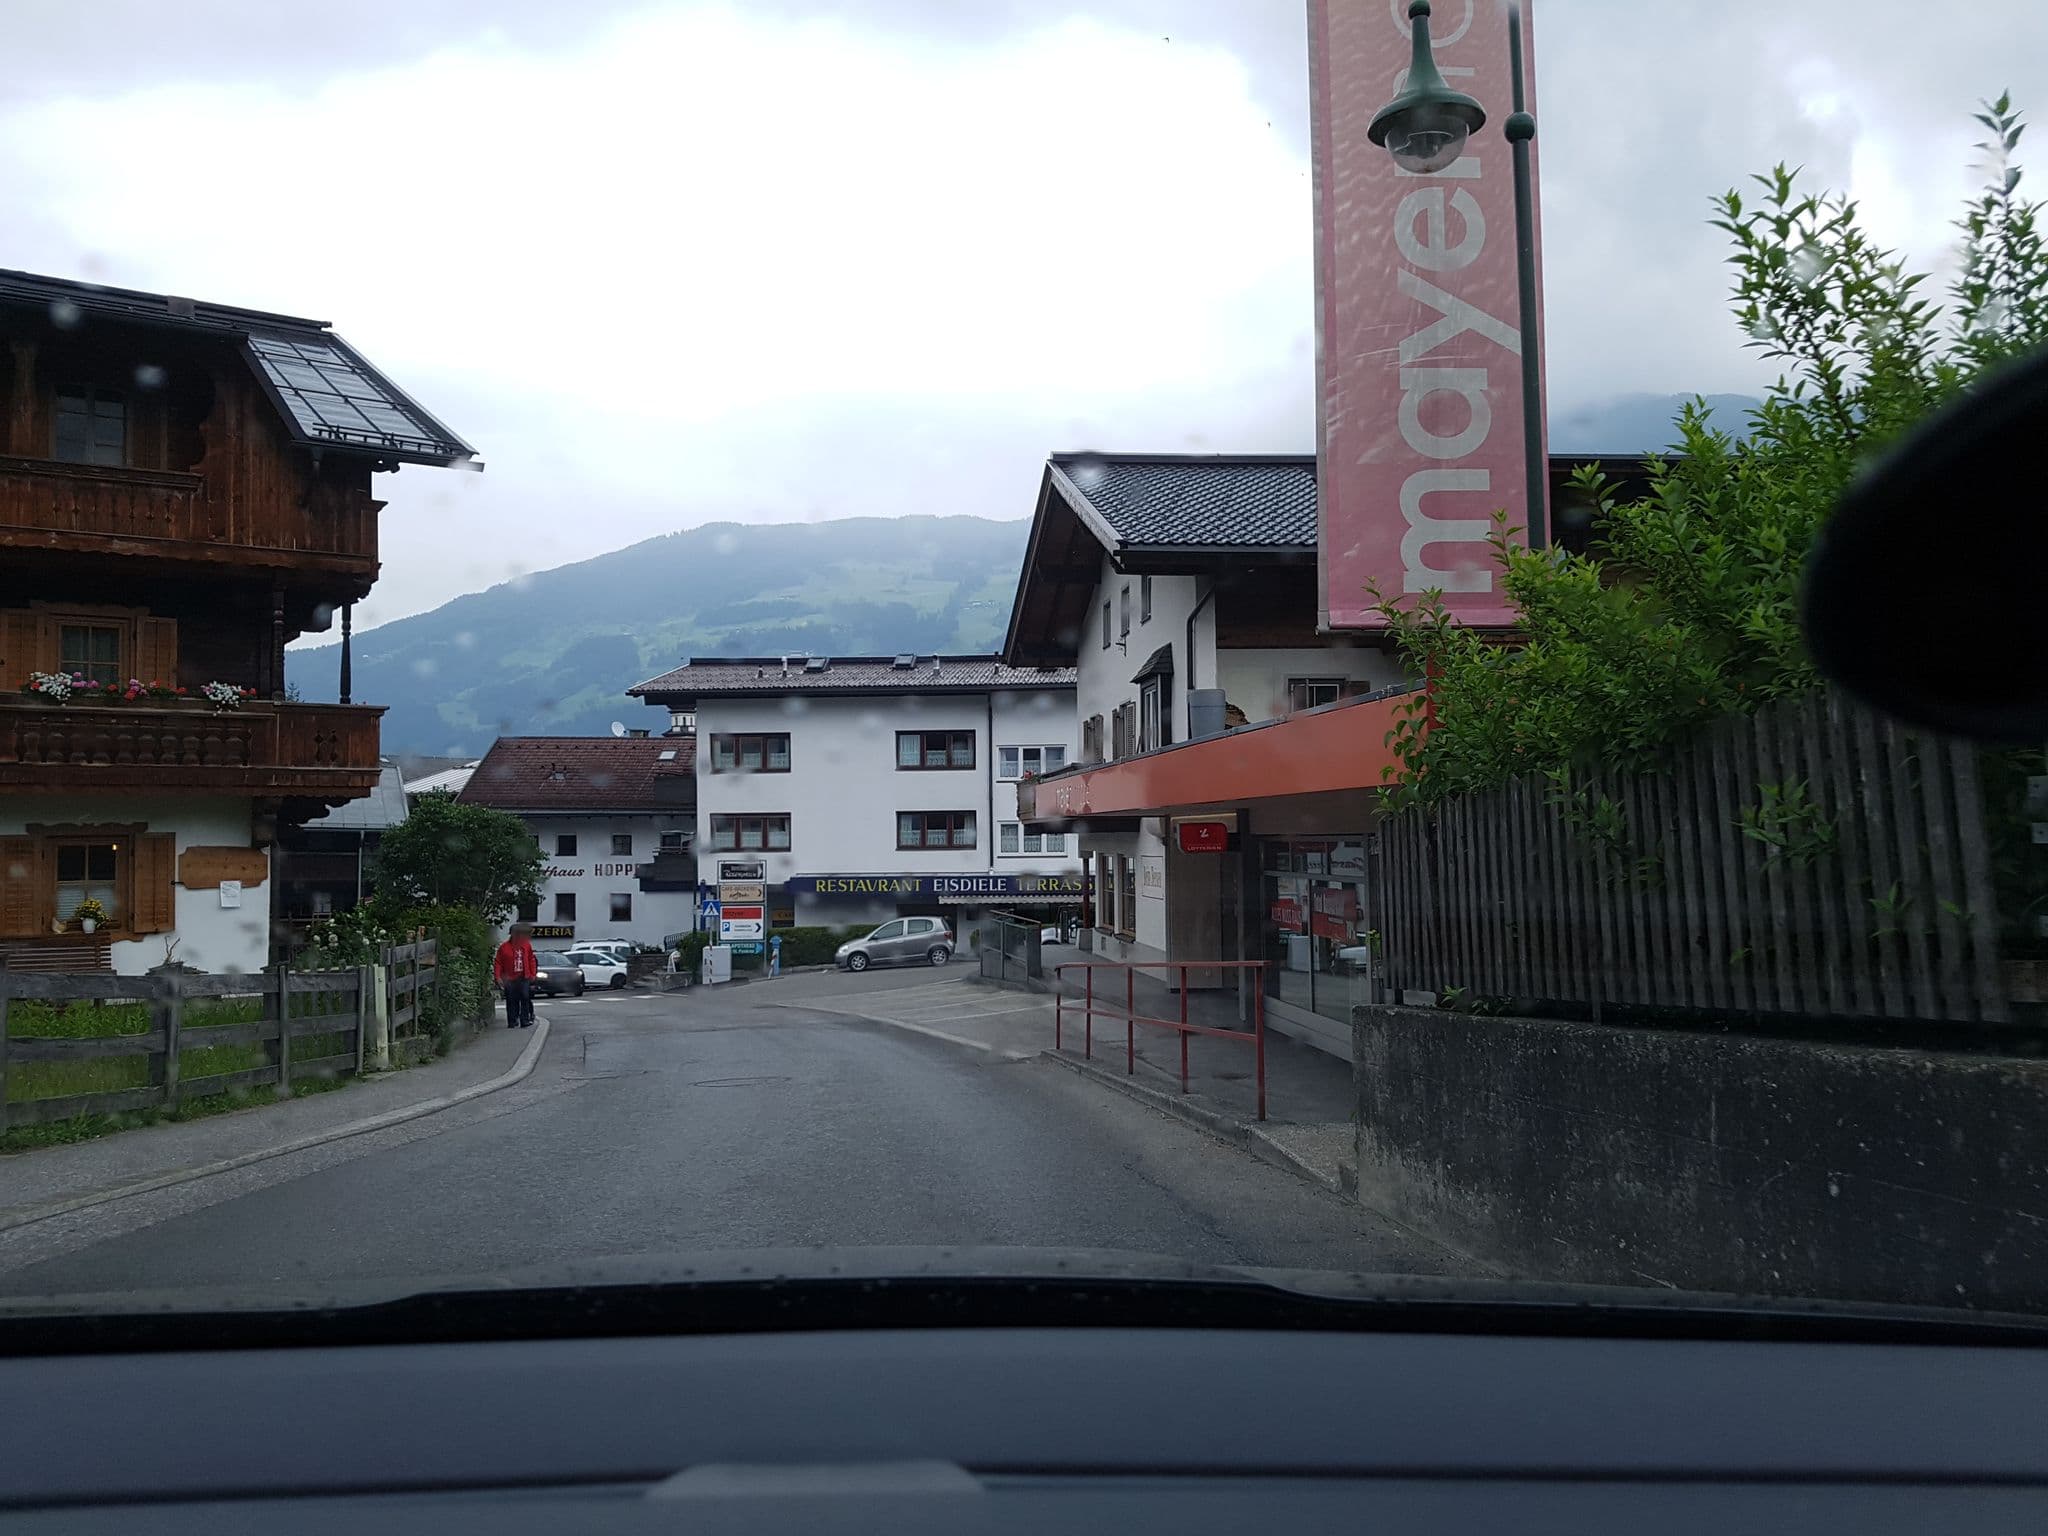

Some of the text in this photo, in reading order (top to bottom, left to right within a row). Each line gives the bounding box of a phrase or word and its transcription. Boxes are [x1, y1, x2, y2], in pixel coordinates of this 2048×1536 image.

[542, 865, 585, 877] thaus
[933, 879, 1007, 892] EISDIELE
[530, 927, 572, 936] ZZERIA
